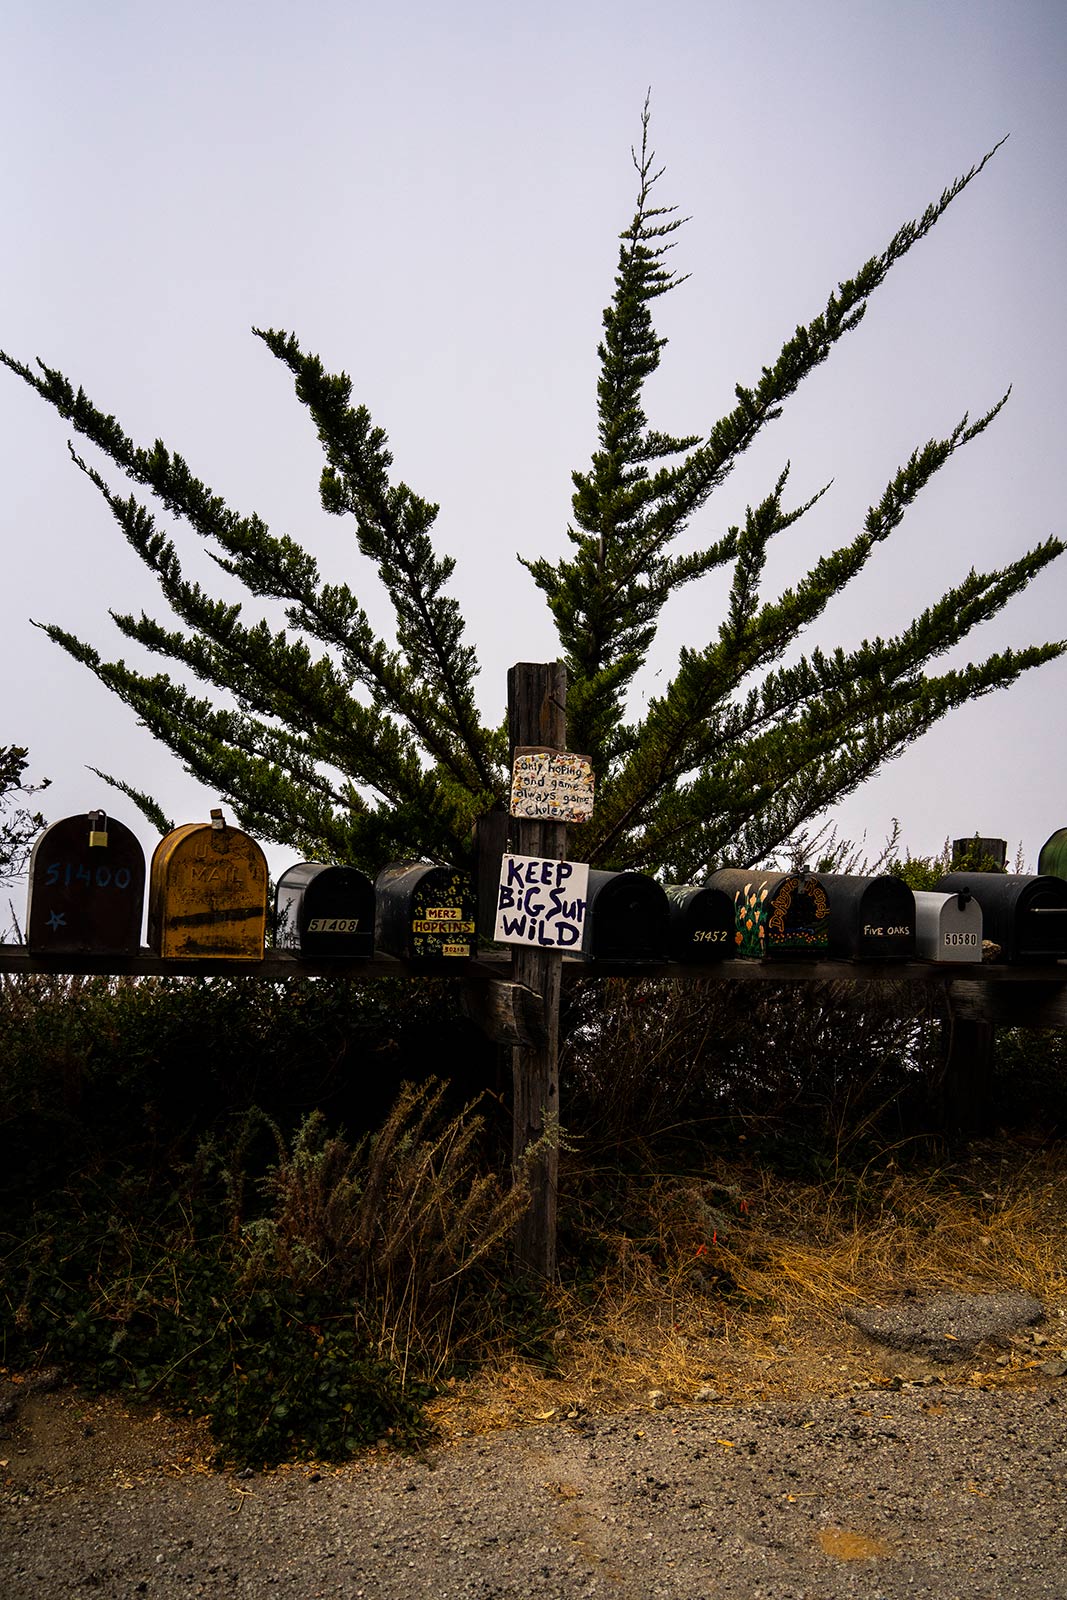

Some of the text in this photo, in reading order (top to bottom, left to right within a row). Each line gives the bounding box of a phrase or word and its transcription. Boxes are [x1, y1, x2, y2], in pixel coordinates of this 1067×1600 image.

[548, 761, 582, 780] hoping
[523, 775, 546, 787] and
[516, 789, 557, 803] always
[45, 862, 133, 889] 51400
[190, 866, 244, 883] MAIL
[507, 858, 573, 889] KEEP
[310, 920, 357, 932] 51408
[415, 921, 472, 933] HOPKINS
[886, 926, 910, 936] OAKS
[692, 930, 728, 942] 51452
[945, 933, 977, 946] 50580
